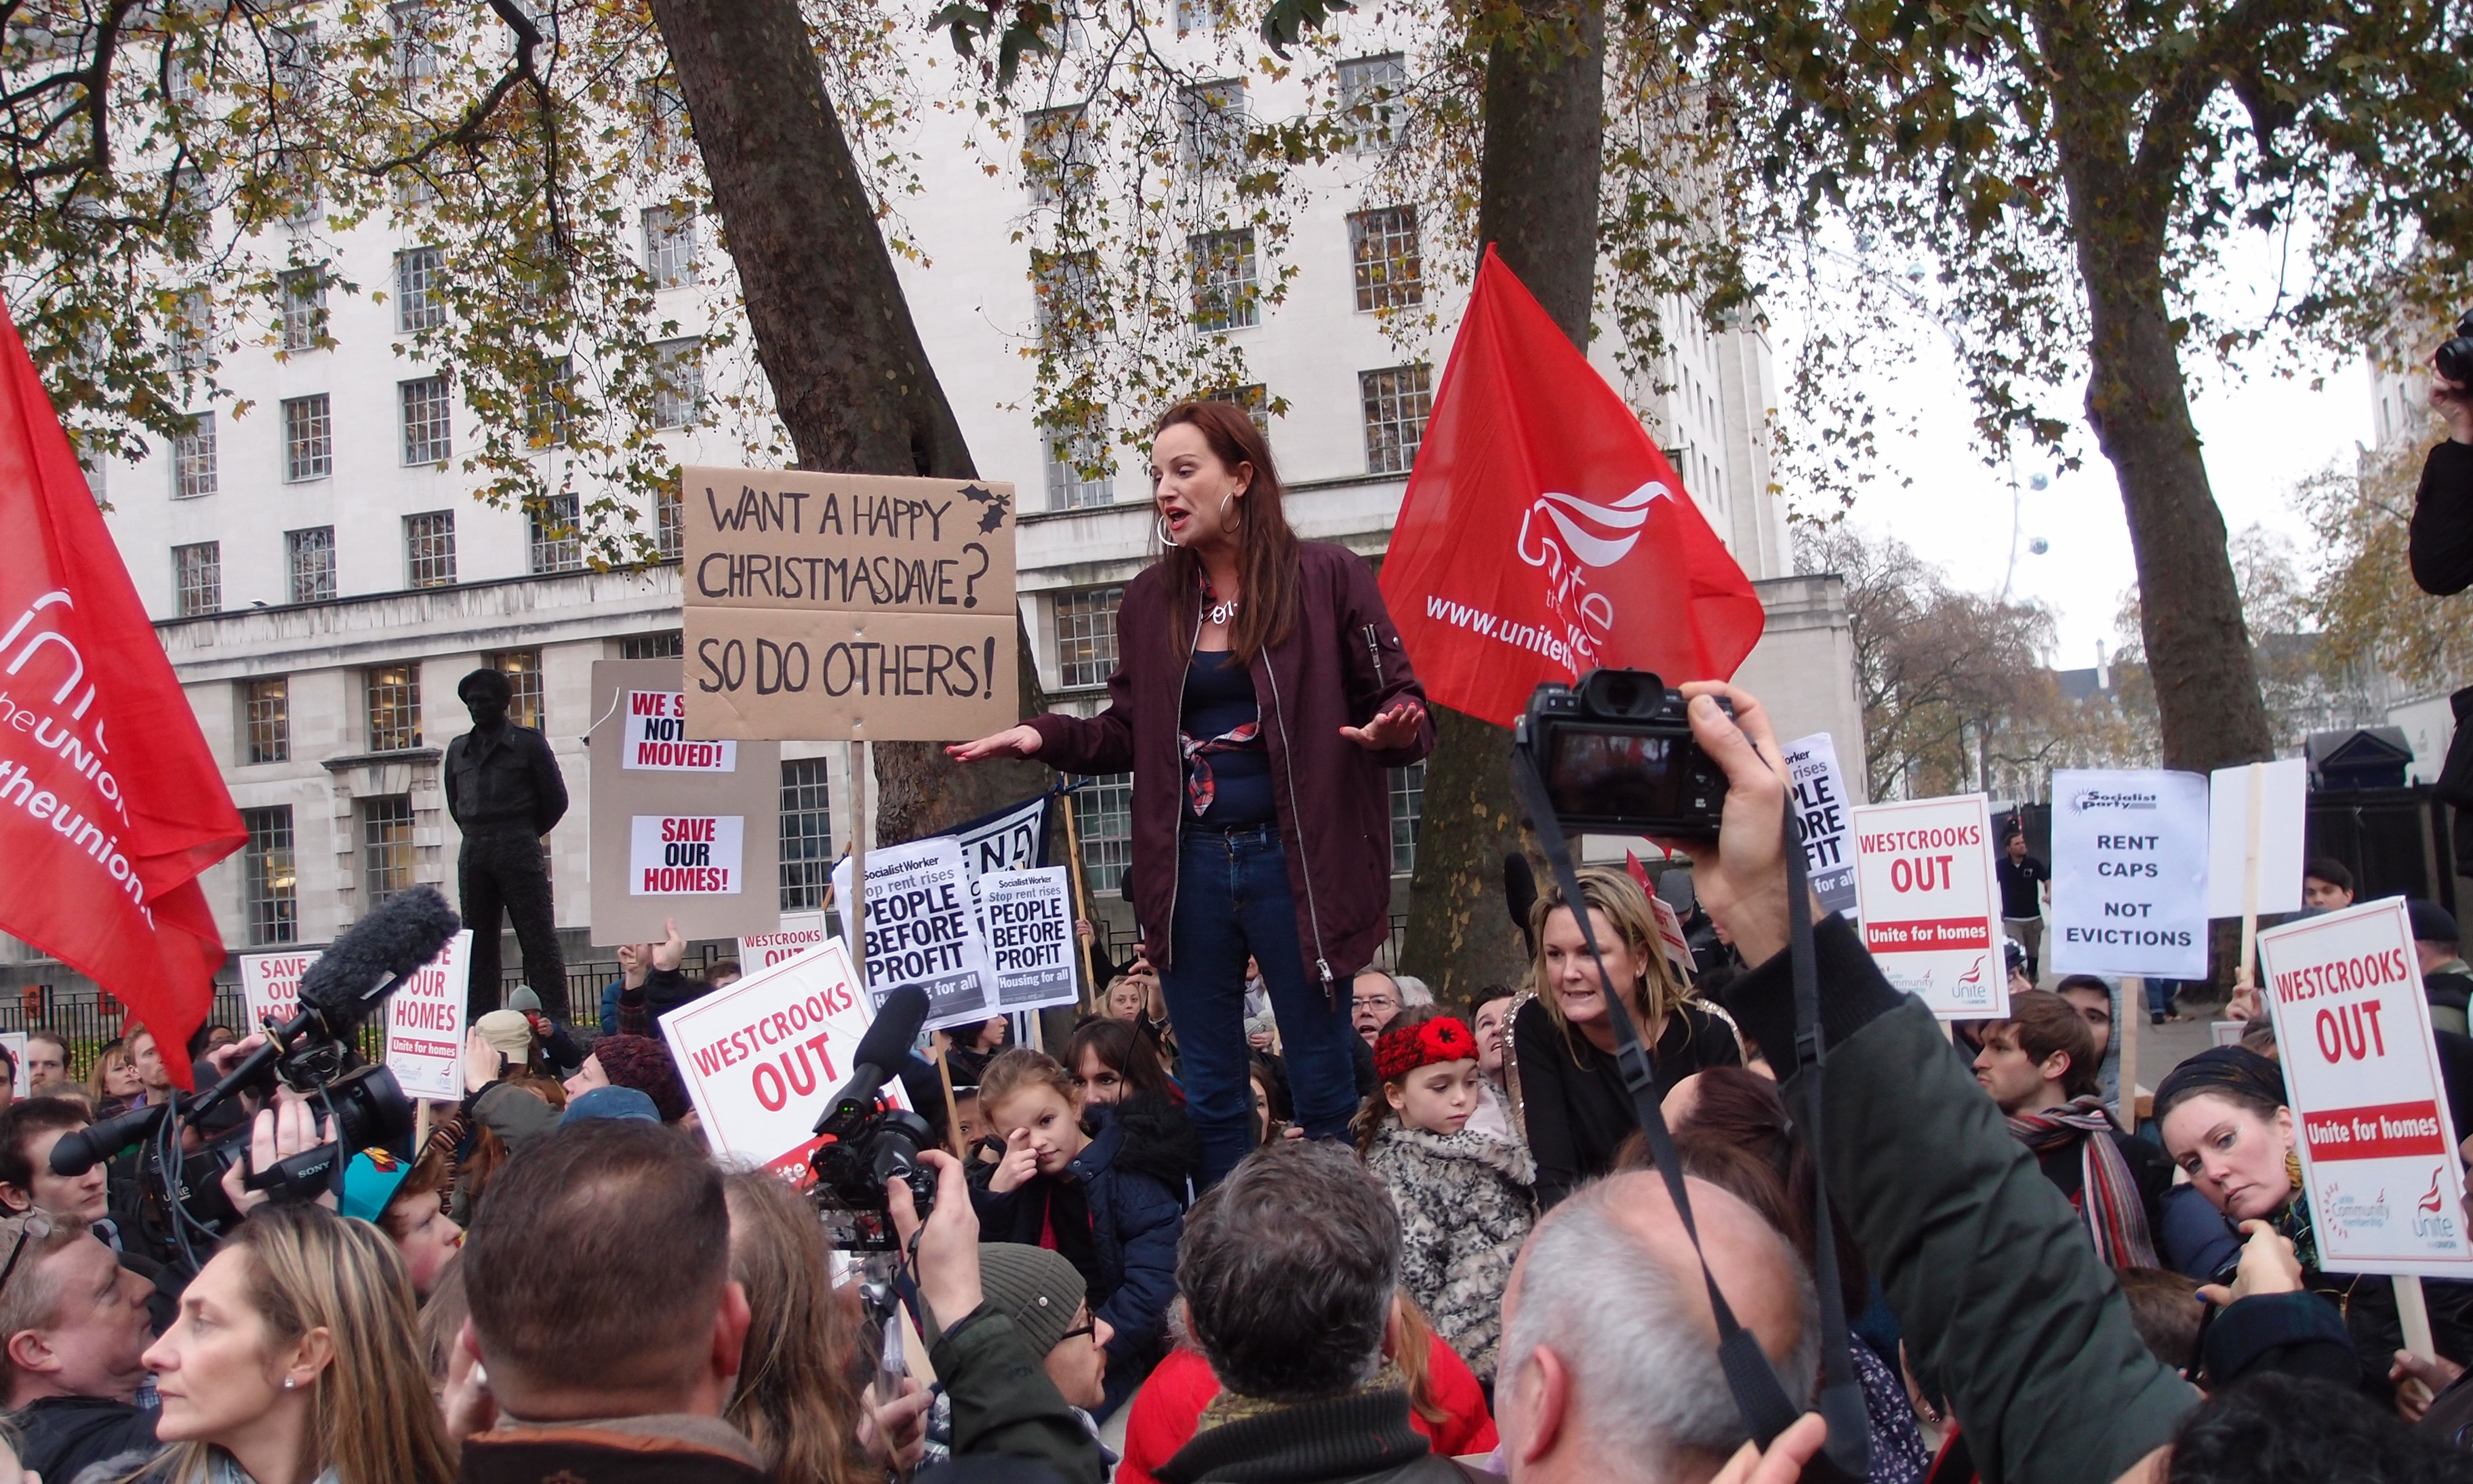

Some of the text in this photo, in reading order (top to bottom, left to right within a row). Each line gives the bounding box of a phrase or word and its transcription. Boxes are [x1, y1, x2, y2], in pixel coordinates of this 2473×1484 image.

[705, 485, 952, 542] WANT A HAPPY
[1427, 595, 1579, 681] www.uniteth
[698, 636, 996, 700] SO DO OTHERS!
[632, 693, 666, 716] WE
[645, 718, 684, 741] NOT
[638, 742, 723, 767] MOVED!
[1783, 750, 1811, 765] orker
[1793, 761, 1828, 780] rises
[2088, 791, 2156, 801] Socialist
[662, 818, 716, 842] SAVE
[1859, 825, 1980, 854] WESTCROOKS
[2097, 835, 2159, 850] RENT
[665, 843, 710, 866] OUR
[644, 867, 728, 892] HOMES!
[888, 875, 917, 892] rent
[921, 869, 954, 885] rises
[1891, 855, 1953, 893] OUT
[2098, 862, 2158, 877] CAPS
[989, 886, 1061, 902] Stop rent rises
[1815, 878, 1835, 893] for
[990, 898, 1062, 925] PEOPLE
[2104, 902, 2152, 918] NOT
[744, 930, 820, 948] WESTCROOKS
[865, 910, 969, 958] BEFORE
[992, 920, 1066, 948] BEFORE
[1869, 925, 1987, 943] Unite for homes
[2066, 928, 2192, 946] EVICTIONS
[866, 941, 963, 987] PROFIT
[995, 943, 1062, 971] PROFIT
[260, 959, 307, 979] SAVE
[999, 969, 1069, 988] Housing for all
[2276, 948, 2407, 1003] WESTCROOKS
[410, 970, 445, 998] OUR
[935, 974, 978, 996] for all
[1893, 978, 1933, 988] mmunity
[1952, 984, 1986, 999] unite
[396, 1000, 456, 1032] HOMES
[692, 982, 853, 1078] WESTCROOKS
[2316, 999, 2385, 1064] OUT
[393, 1039, 456, 1057] Unite for homes
[752, 1031, 838, 1112] OUT
[2308, 1115, 2438, 1144] Unite for homes
[298, 1161, 329, 1178] SONY
[2413, 1215, 2454, 1237] unite
